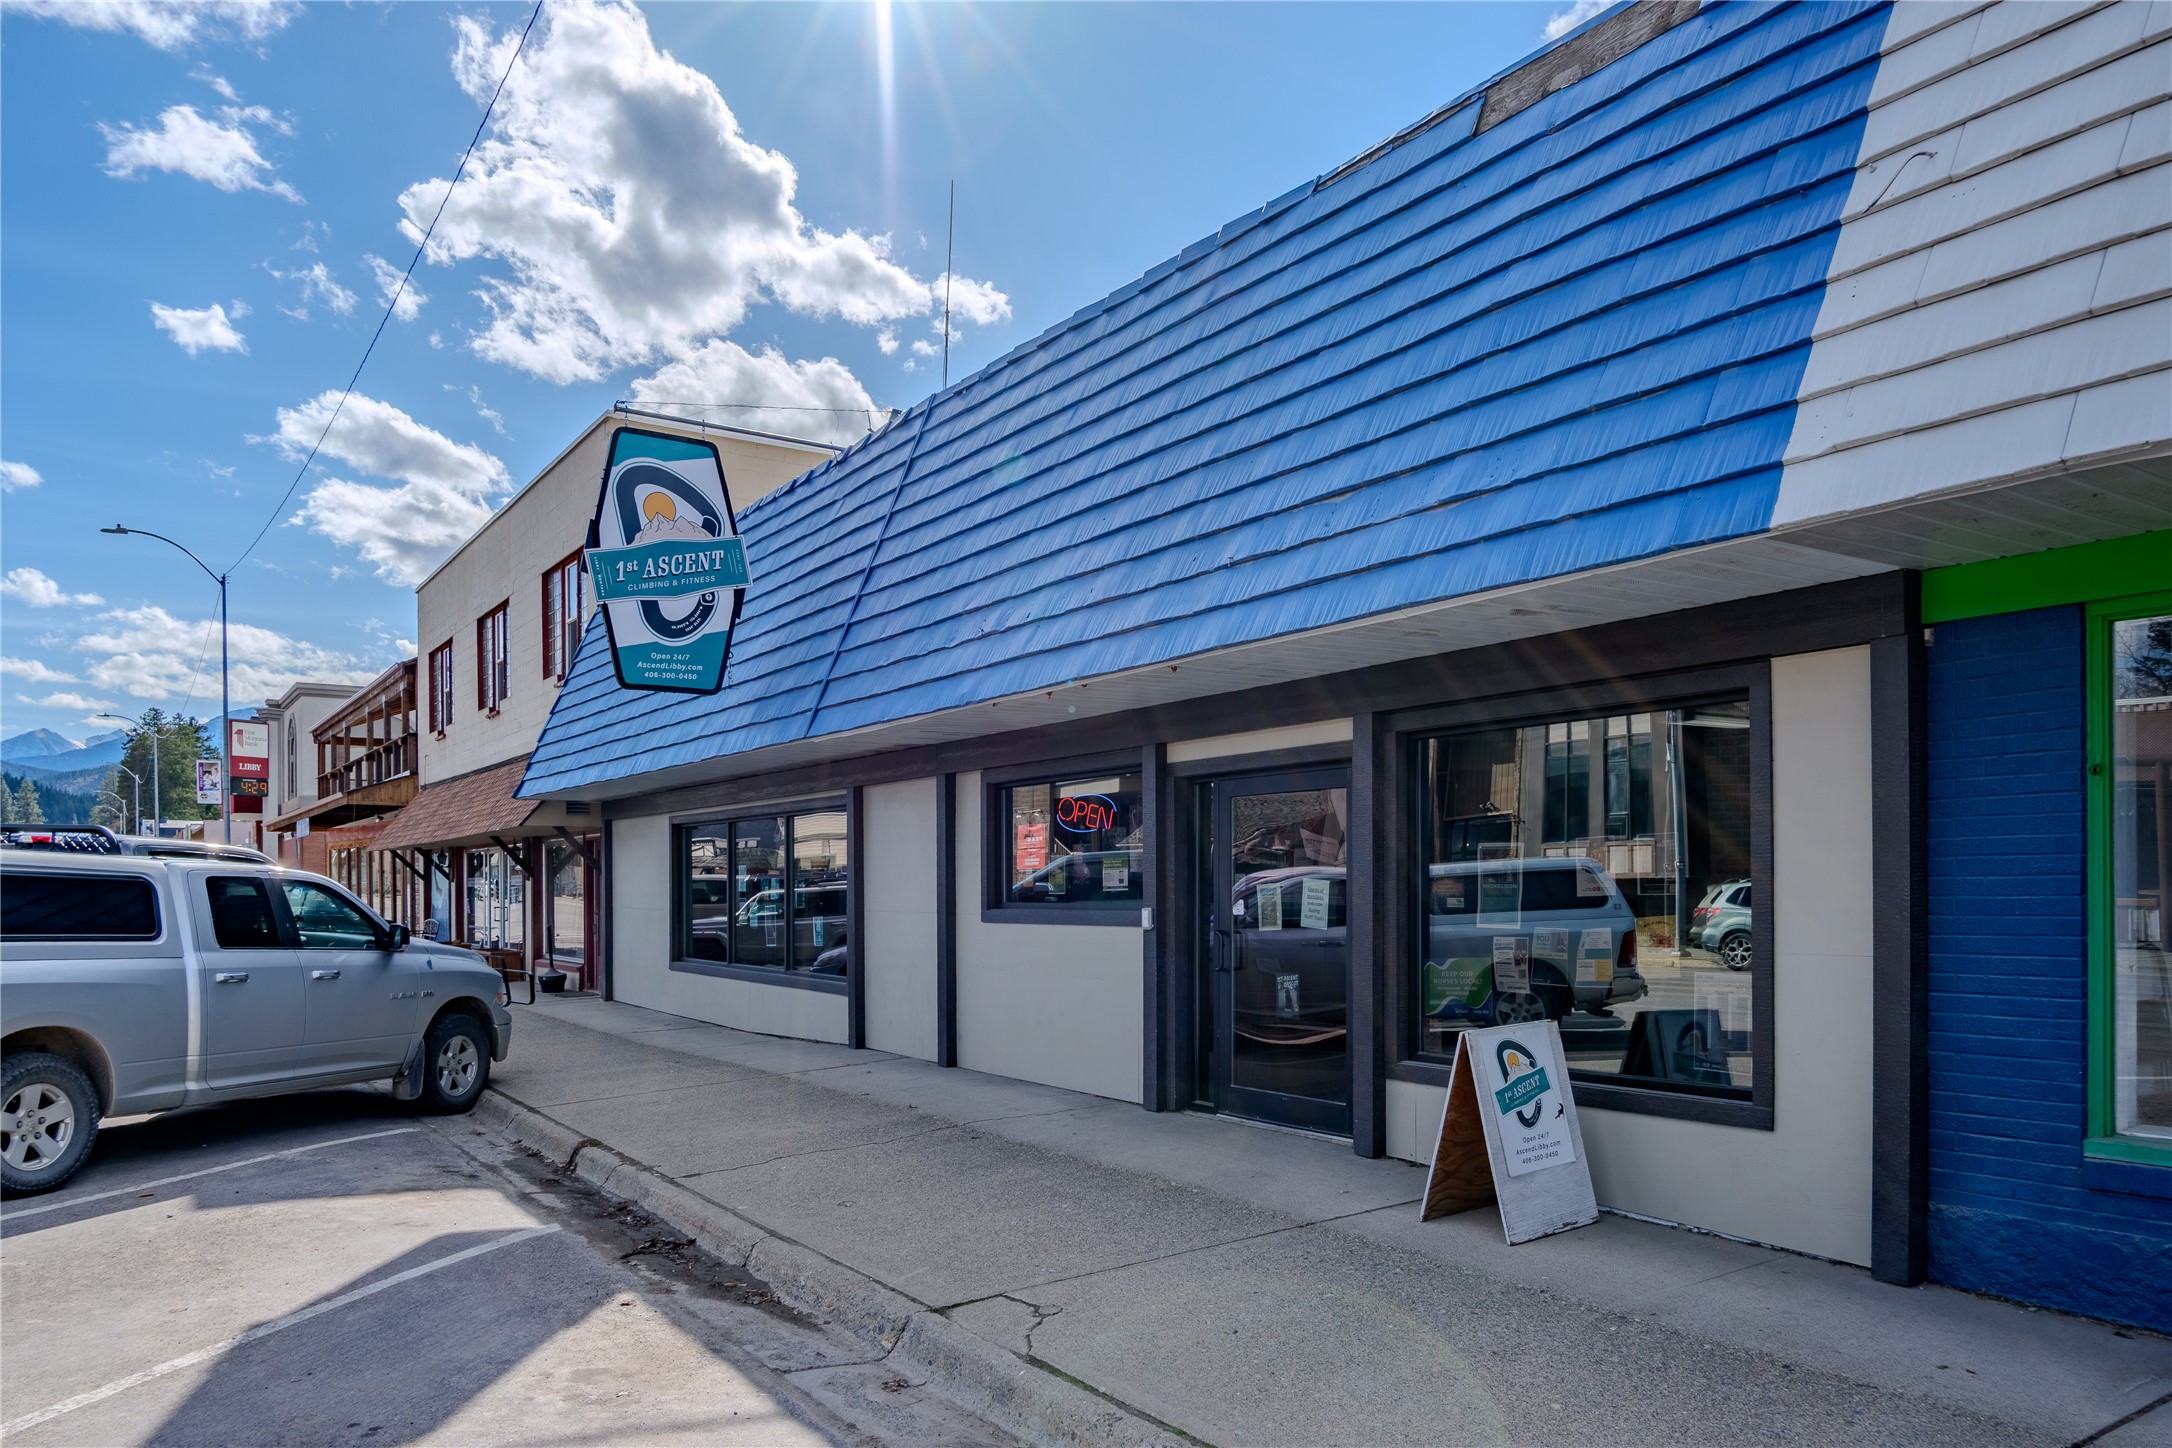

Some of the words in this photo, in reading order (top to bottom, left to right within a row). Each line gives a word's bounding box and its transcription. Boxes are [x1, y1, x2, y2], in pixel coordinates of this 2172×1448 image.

[615, 560, 639, 582] 1st
[641, 549, 725, 579] ASCENT
[627, 580, 670, 591] CLIMBING
[681, 575, 716, 585] FITNESS
[650, 652, 671, 660] Open
[672, 653, 690, 661] 24/7
[636, 661, 704, 671] AscendLibby.com
[644, 671, 698, 680] 406-300-0450
[239, 763, 262, 772] LIBBY
[241, 782, 268, 795] 4:29
[1058, 797, 1115, 830] OPEN
[1504, 1090, 1513, 1103] 1st
[1513, 1074, 1540, 1099] ASCENT
[1522, 1136, 1537, 1144] Open
[1537, 1131, 1549, 1140] 24/7
[1515, 1140, 1561, 1155] AscendLibby.com
[1522, 1150, 1559, 1164] 406-300-0450
